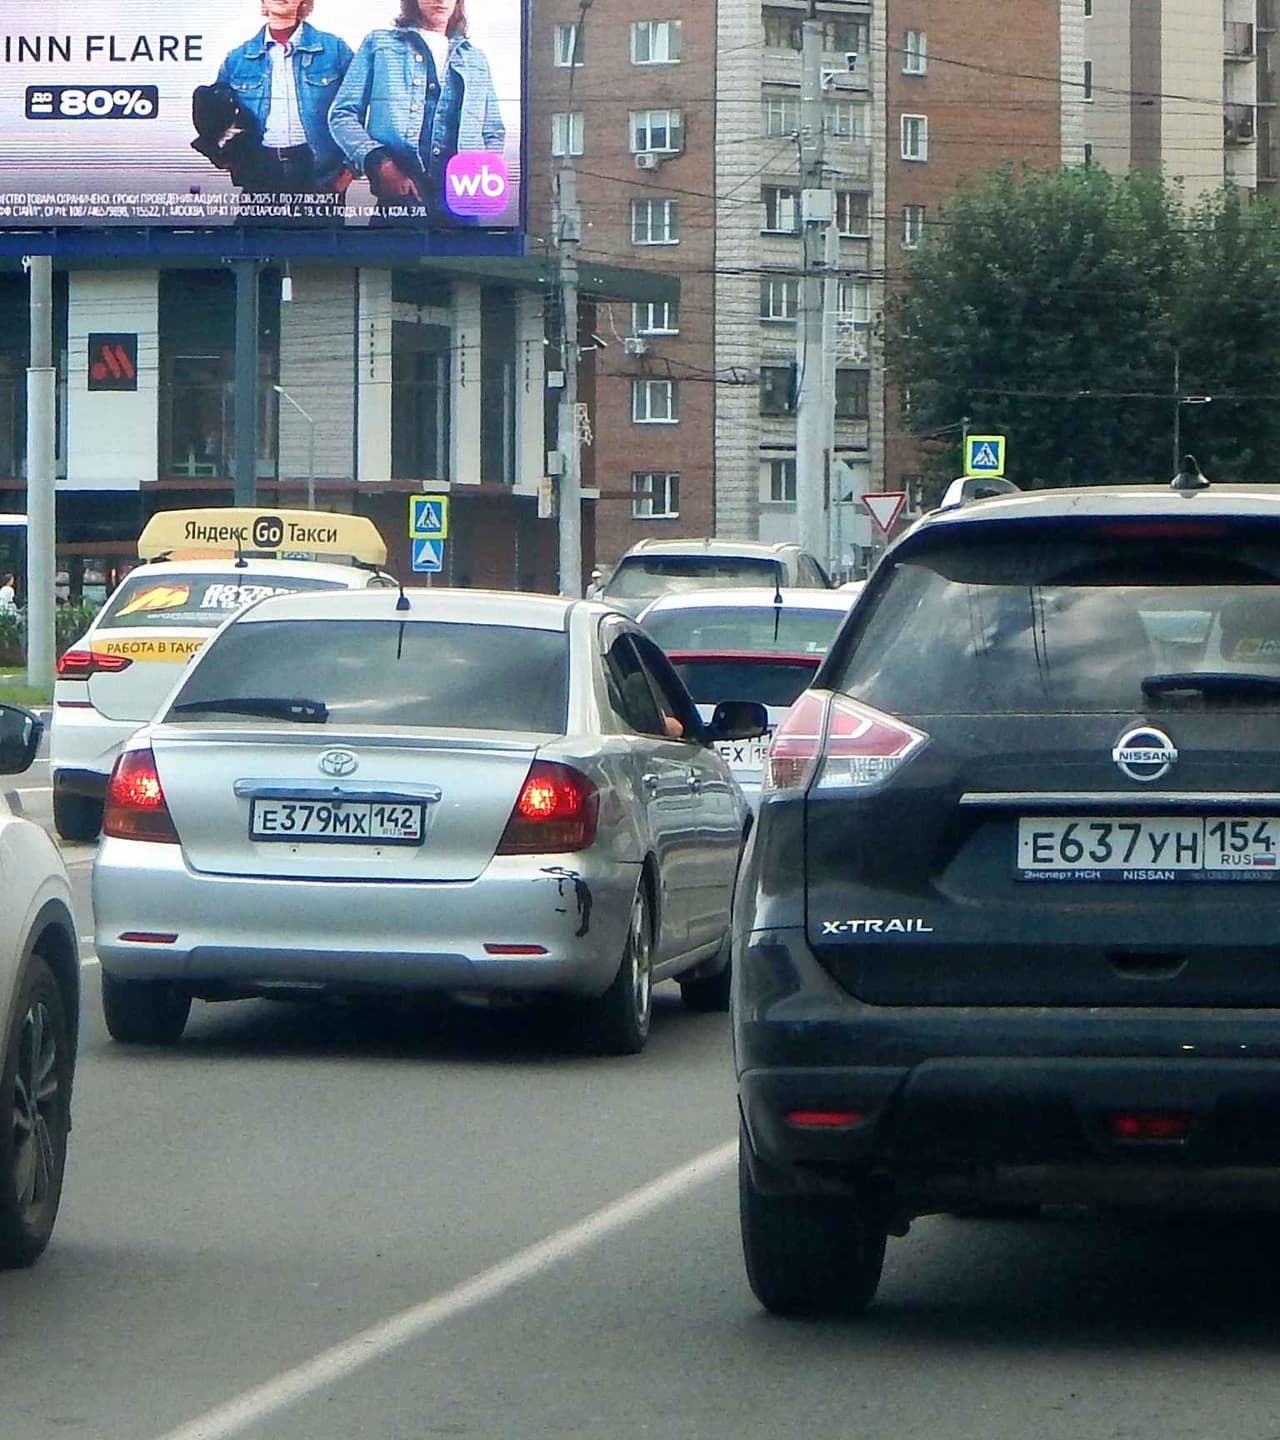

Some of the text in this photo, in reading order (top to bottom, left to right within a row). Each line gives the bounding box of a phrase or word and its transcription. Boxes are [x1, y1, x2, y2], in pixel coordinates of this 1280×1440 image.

[86, 34, 203, 62] FLARE
[450, 162, 505, 199] wb
[185, 521, 338, 544] Яндекс Go Такси
[106, 641, 203, 654] РАБОТА В ТАКС
[1119, 751, 1171, 761] NISSAN
[374, 806, 414, 830] 142
[1209, 820, 1271, 853] 154
[1220, 853, 1252, 866] RUS
[1123, 870, 1176, 881] NISSAN
[821, 918, 934, 935] X-TRAIL
